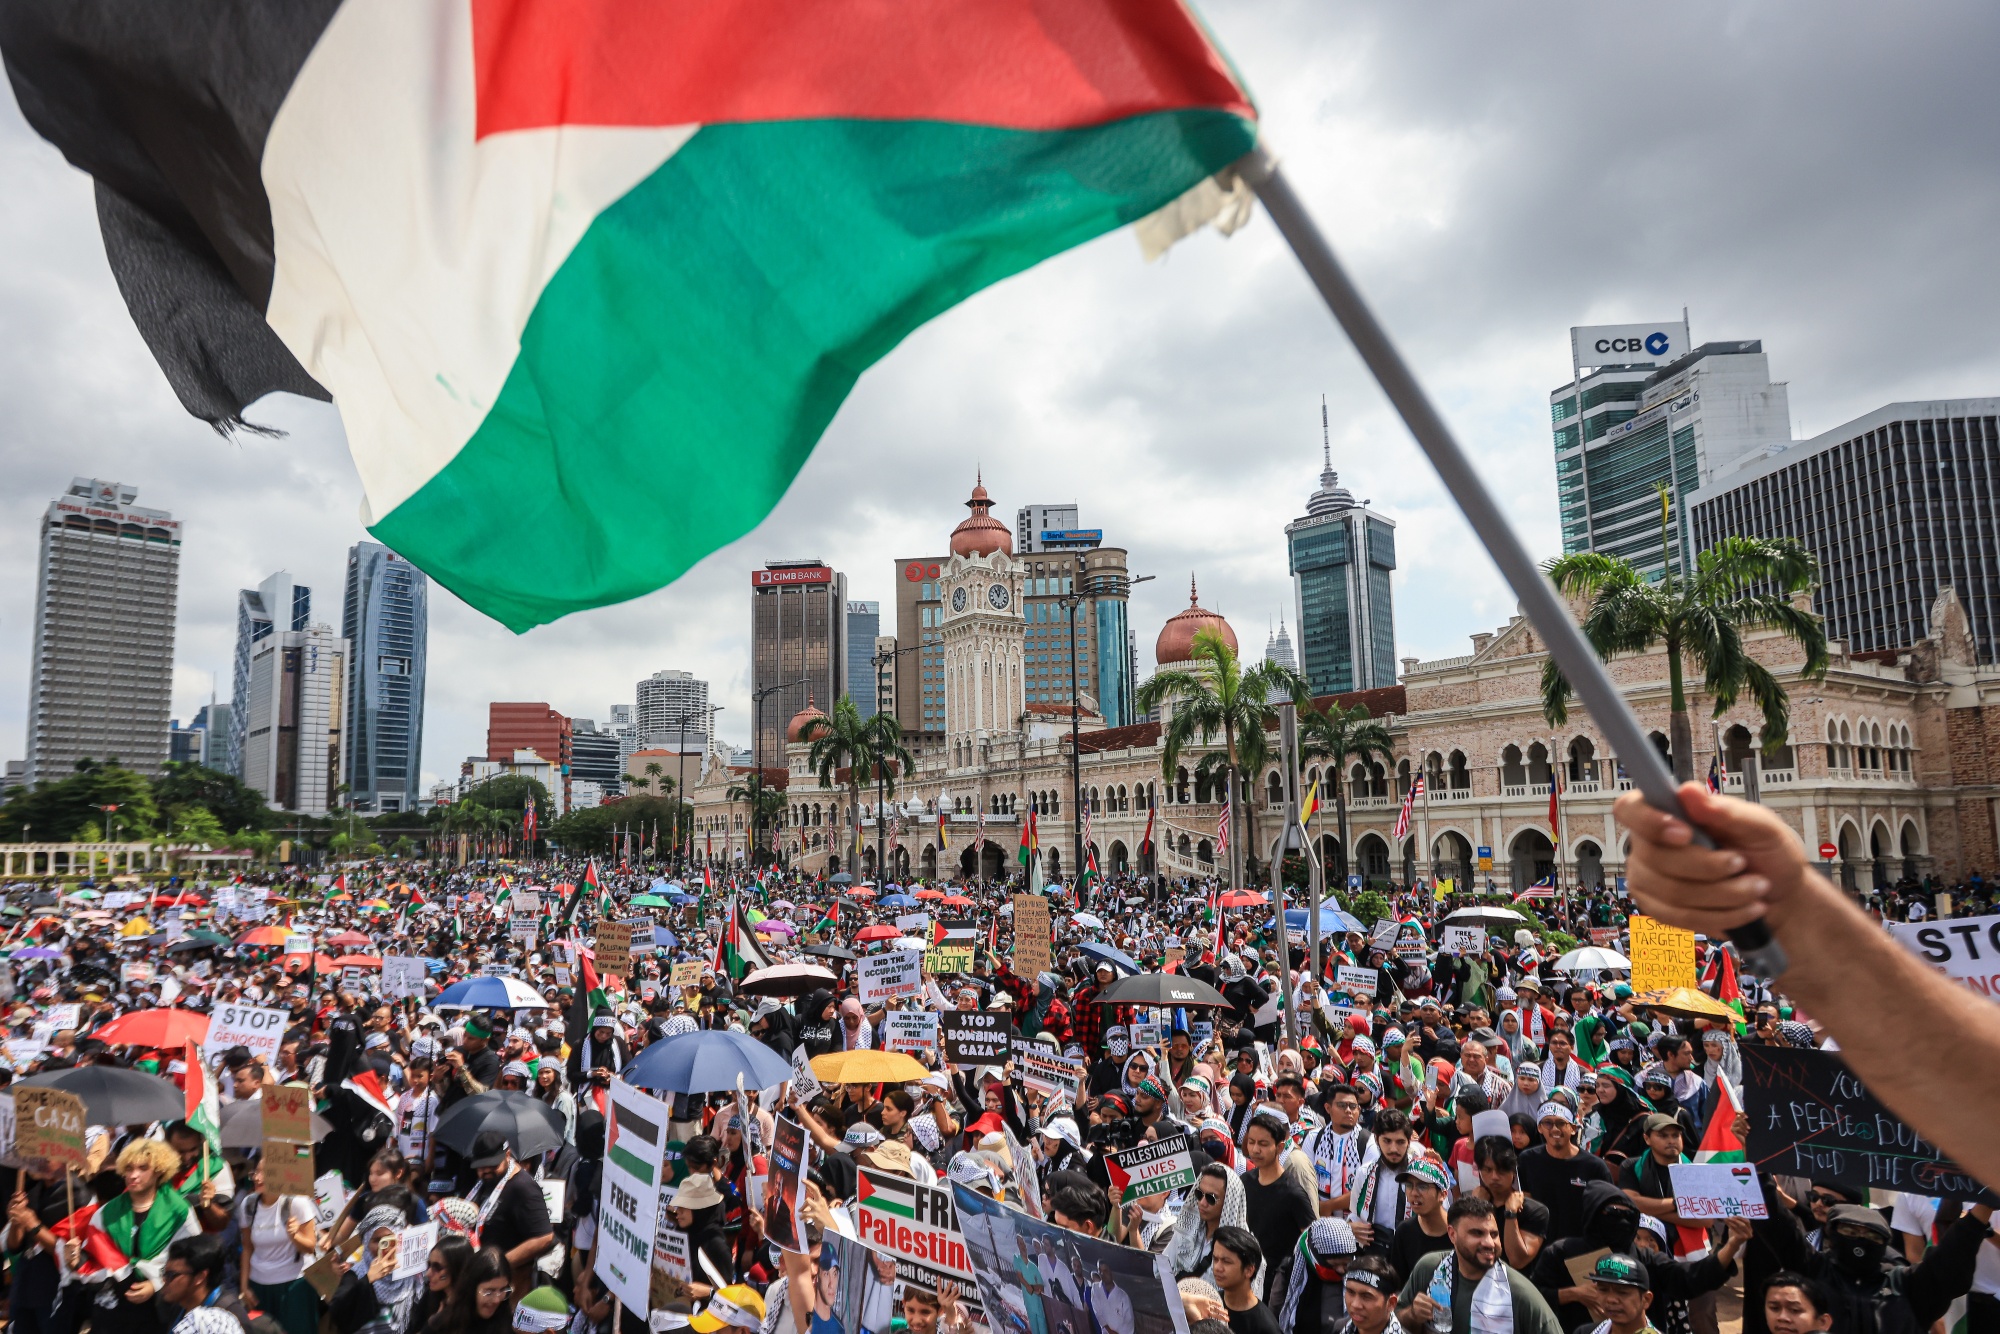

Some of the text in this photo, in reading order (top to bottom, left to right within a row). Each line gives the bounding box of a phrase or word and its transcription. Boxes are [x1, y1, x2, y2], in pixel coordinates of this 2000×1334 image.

[1595, 338, 1643, 354] CCB
[1047, 531, 1065, 539] Bank
[773, 571, 822, 581] CIMB BANK
[600, 923, 616, 931] HOW
[1637, 917, 1691, 933] ISR
[631, 935, 652, 944] ESTINE
[949, 935, 975, 954] FREE
[1632, 932, 1694, 949] TARGETS
[596, 953, 618, 961] BABIES
[926, 947, 943, 956] with
[873, 955, 906, 967] END THE
[926, 955, 970, 973] PALESTINE
[864, 962, 915, 978] OCCUPATION
[1631, 961, 1695, 980] BIDEN PAYS
[880, 975, 902, 986] FREE
[1347, 982, 1375, 990] PALESTINE
[1354, 978, 1376, 986] CHILDREN
[867, 983, 916, 999] PALESTINE
[222, 1007, 280, 1030] STOP
[960, 1013, 996, 1027] STOP
[1334, 1009, 1353, 1017] FREE
[891, 1021, 934, 1029] OCCUPATION
[213, 1031, 276, 1049] GENOCIDE
[892, 1038, 932, 1047] PALESTINE
[947, 1029, 1008, 1045] BOMBING
[958, 1043, 995, 1057] GAZA
[1012, 1040, 1054, 1055] PEN THE
[1027, 1051, 1076, 1072] MALAYSIA
[1031, 1062, 1073, 1078] STANDS WITH
[34, 1105, 81, 1134] GAZA
[1767, 1103, 1782, 1131] A
[1789, 1101, 1857, 1137] PEACE
[1118, 1137, 1185, 1168] PALESTINIAN
[1139, 1159, 1177, 1180] LIVES
[1792, 1141, 1846, 1176] HOLD
[1859, 1151, 1905, 1186] THE
[1134, 1172, 1187, 1197] MATTER
[609, 1181, 638, 1223] FREE
[1676, 1196, 1725, 1218] PALESTINE
[1718, 1197, 1742, 1207] WILL
[1725, 1206, 1742, 1217] BE
[600, 1207, 649, 1264] PALESTINE
[895, 1263, 916, 1280] aeli
